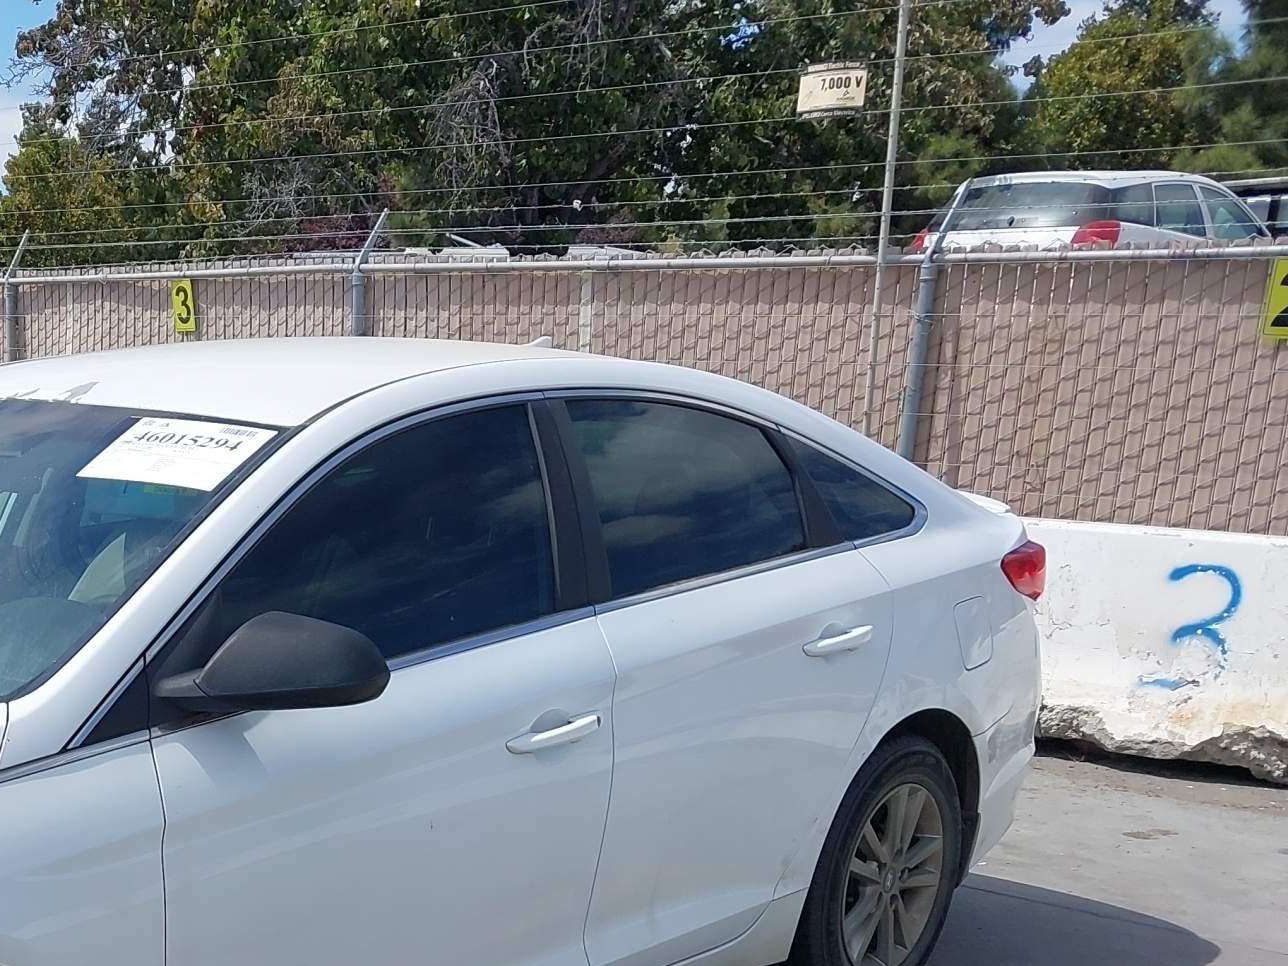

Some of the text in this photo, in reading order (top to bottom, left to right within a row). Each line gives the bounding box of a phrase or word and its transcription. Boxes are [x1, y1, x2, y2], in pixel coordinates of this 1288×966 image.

[820, 76, 863, 92] 7,000 V
[175, 285, 191, 324] 3
[133, 429, 244, 452] 46015294
